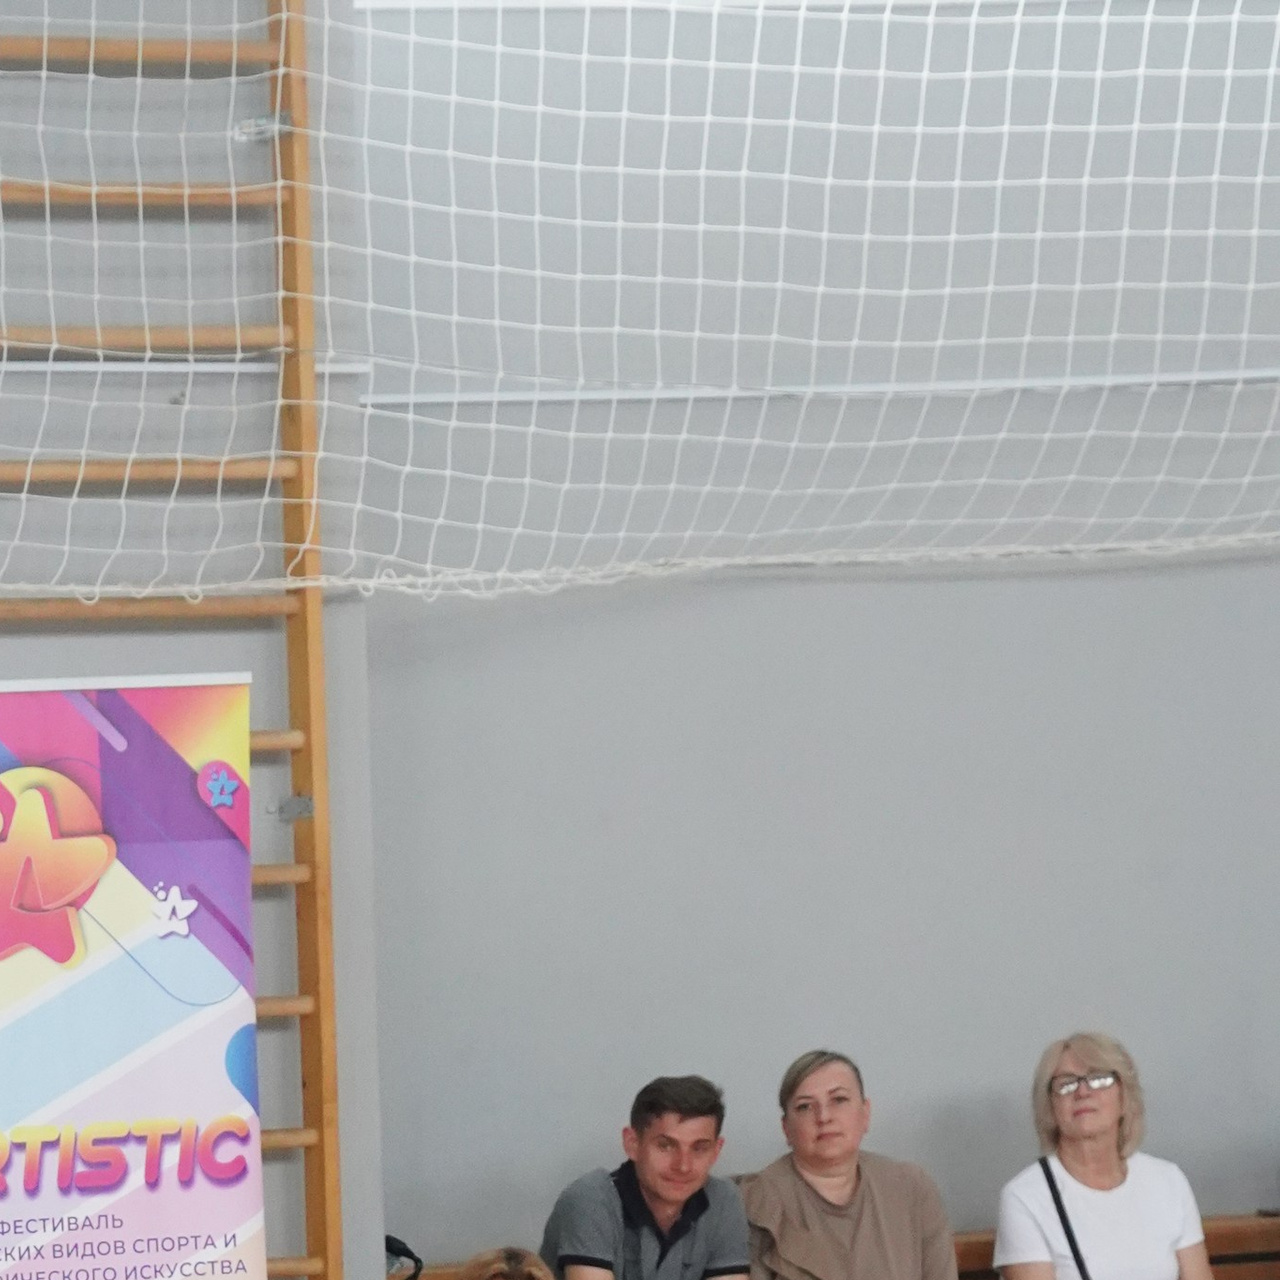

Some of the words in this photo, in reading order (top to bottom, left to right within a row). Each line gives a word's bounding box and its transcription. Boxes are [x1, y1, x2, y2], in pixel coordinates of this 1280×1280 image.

[51, 1240, 127, 1260] ВИДОВ
[132, 1234, 218, 1254] СПОРТА
[223, 1232, 238, 1248] И
[124, 1259, 248, 1280] ИСКУССТВА
